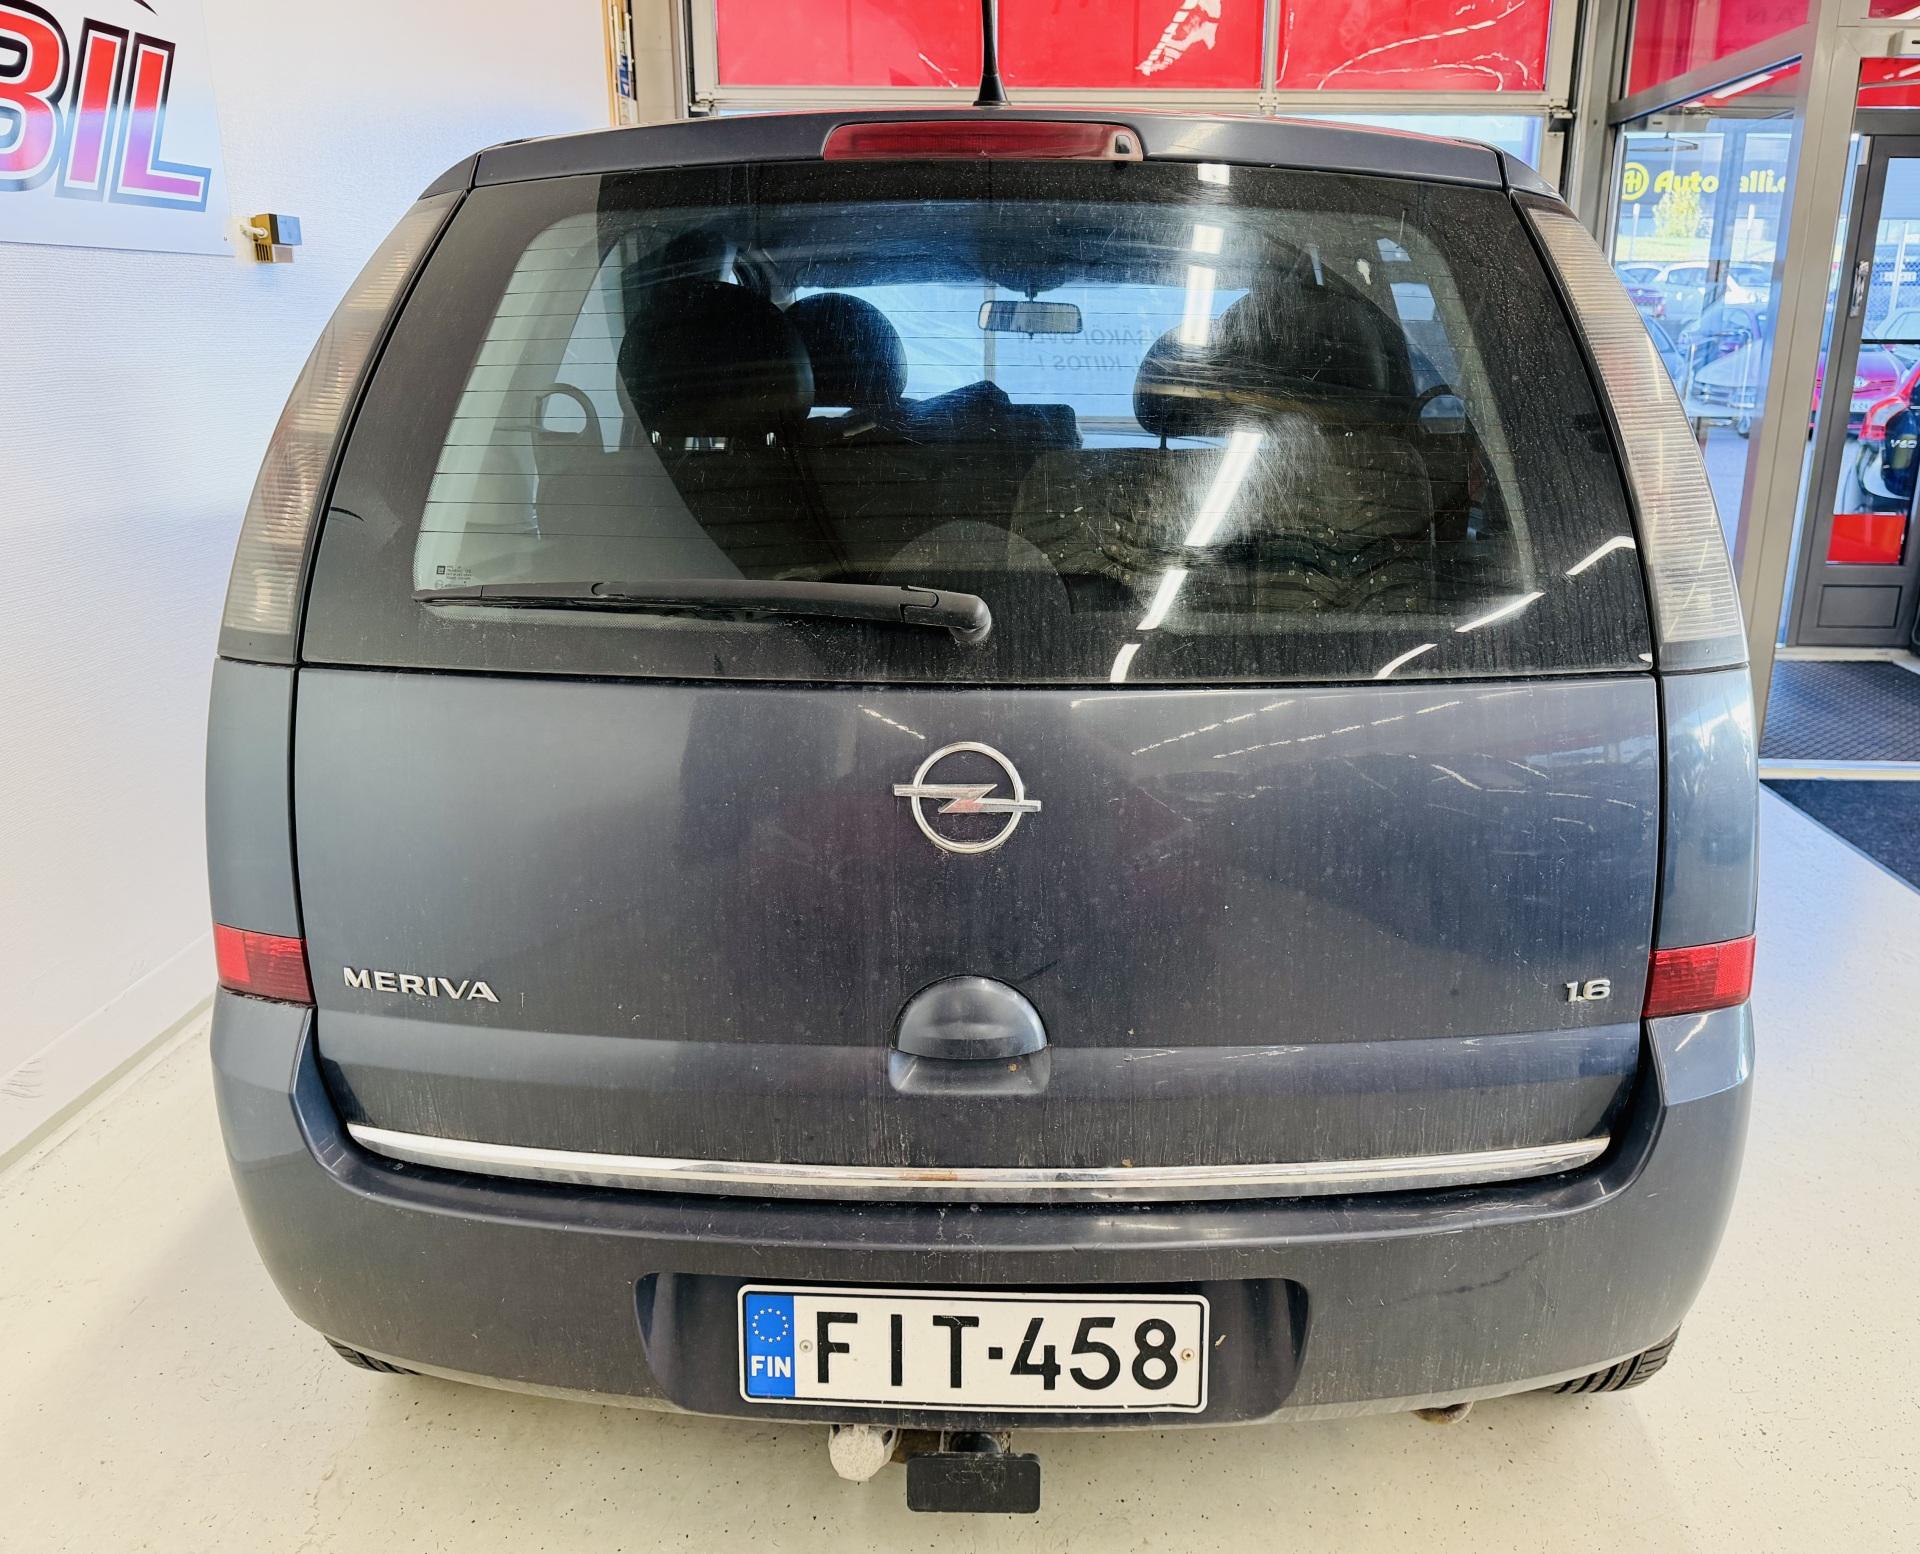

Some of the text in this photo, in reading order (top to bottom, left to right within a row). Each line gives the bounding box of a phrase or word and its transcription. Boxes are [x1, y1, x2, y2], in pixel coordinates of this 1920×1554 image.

[343, 967, 500, 1003] MERIVA
[1566, 979, 1611, 1002] 1.6
[750, 1355, 792, 1379] FIN
